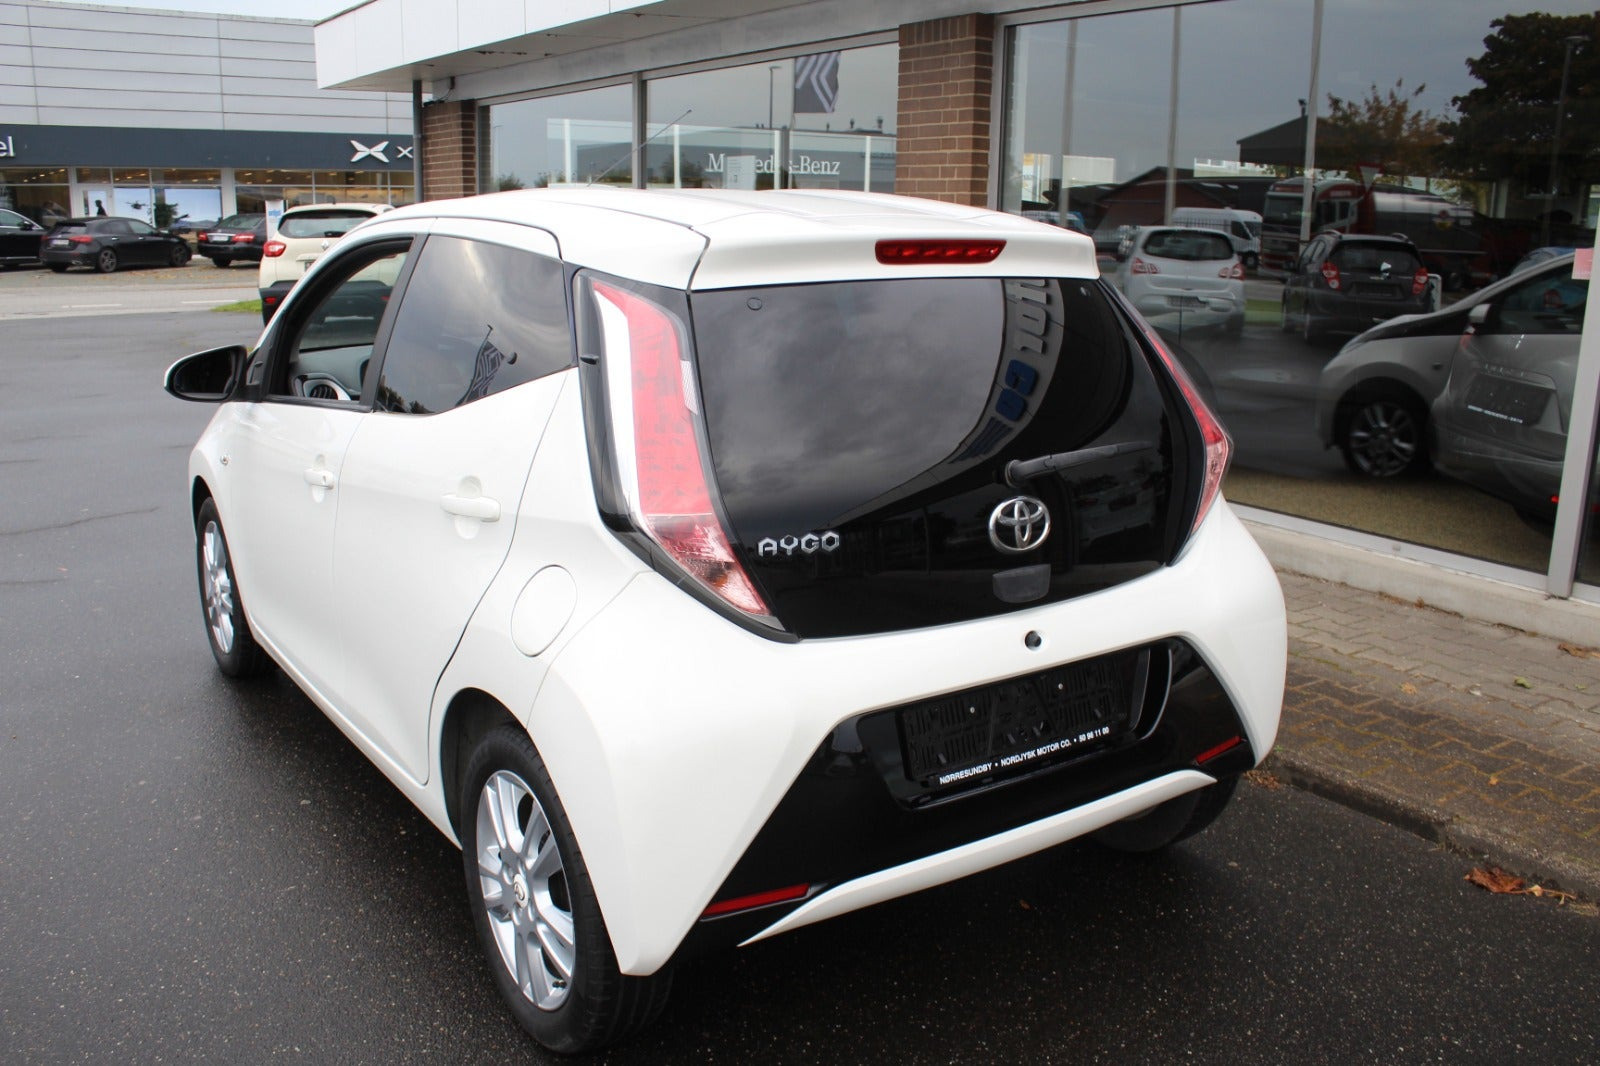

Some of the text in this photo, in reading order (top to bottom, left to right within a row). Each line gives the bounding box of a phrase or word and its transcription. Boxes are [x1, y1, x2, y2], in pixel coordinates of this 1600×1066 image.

[757, 531, 840, 557] AYGO
[1000, 750, 1036, 766] NORDJYSK
[1036, 742, 1060, 756] MOTOR
